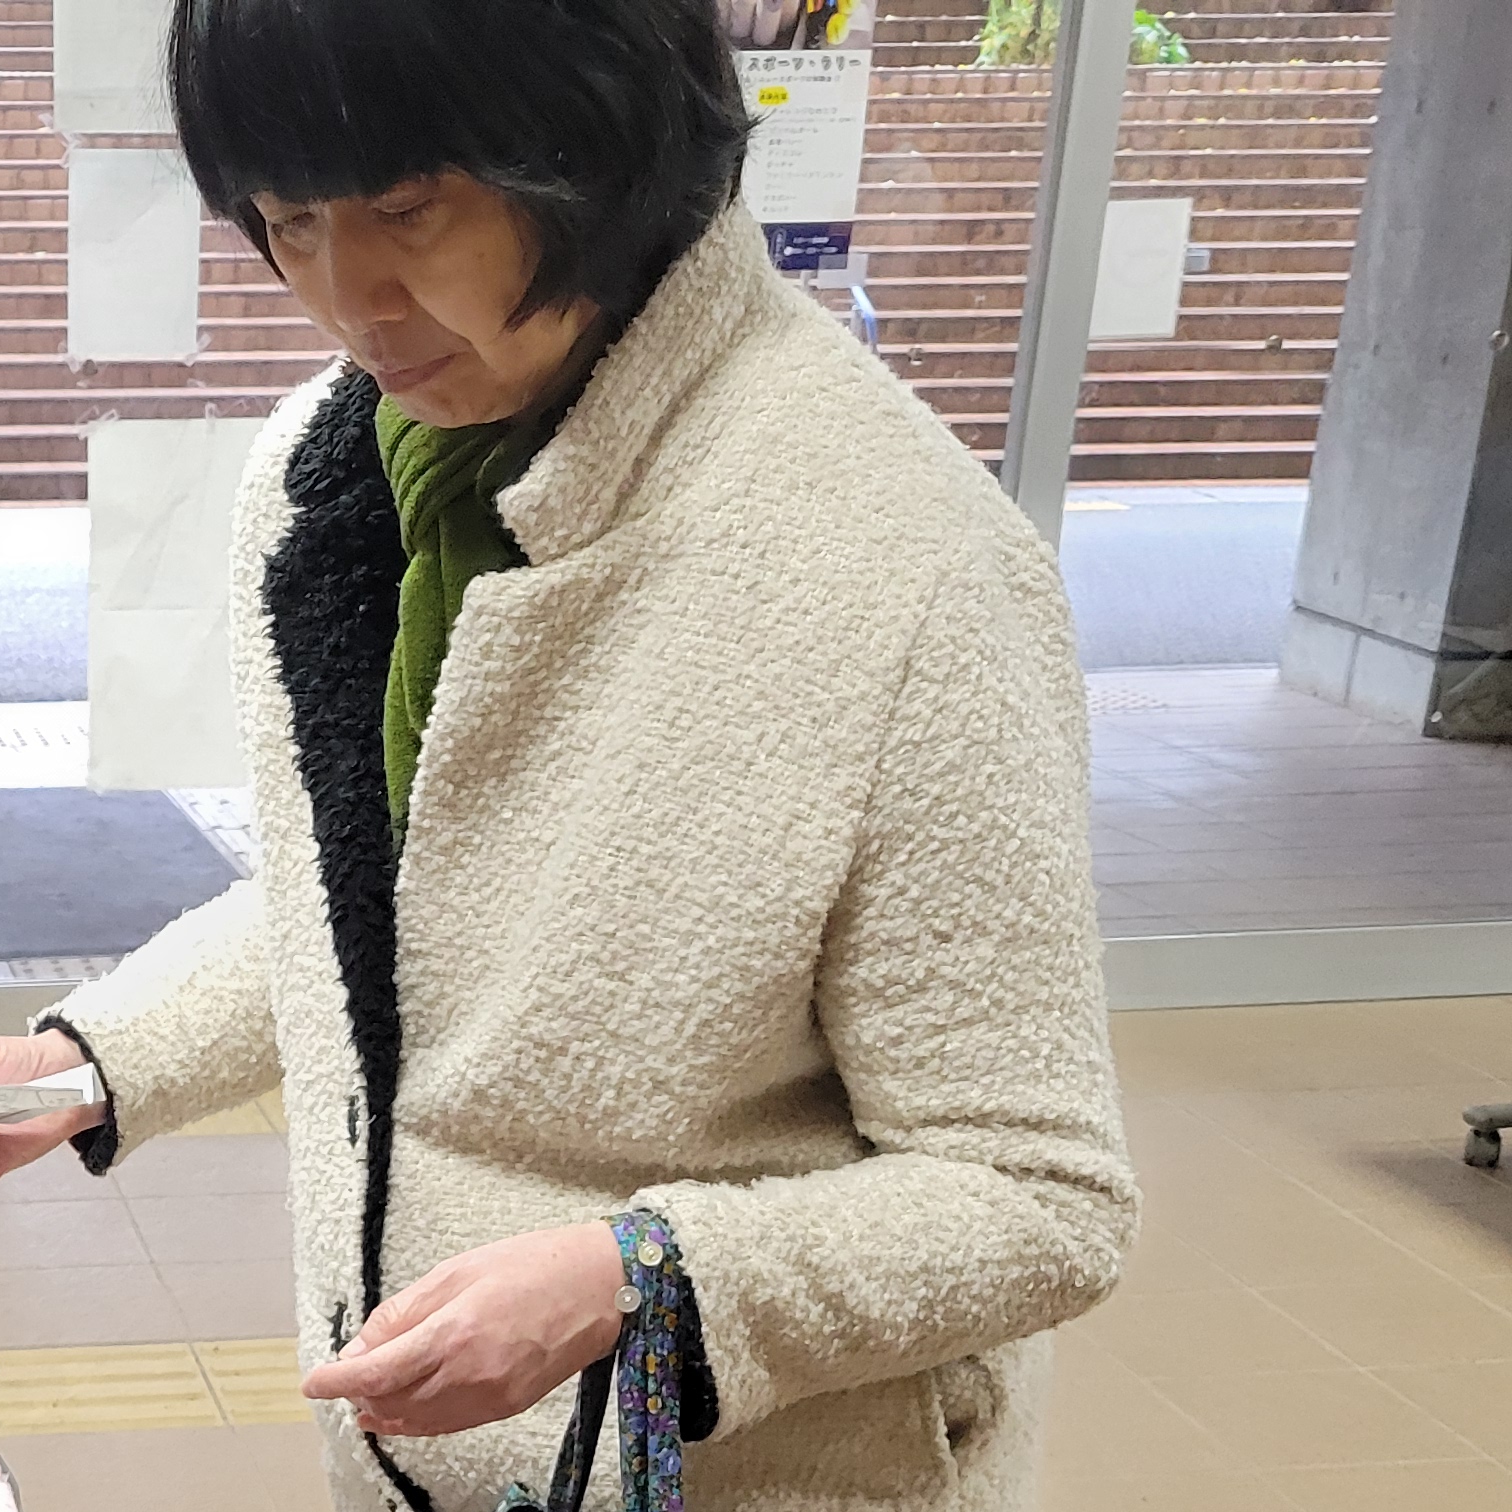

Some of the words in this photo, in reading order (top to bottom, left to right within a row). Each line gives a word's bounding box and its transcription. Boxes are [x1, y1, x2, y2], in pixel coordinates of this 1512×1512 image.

[747, 55, 862, 72] スポーツ・ラリー
